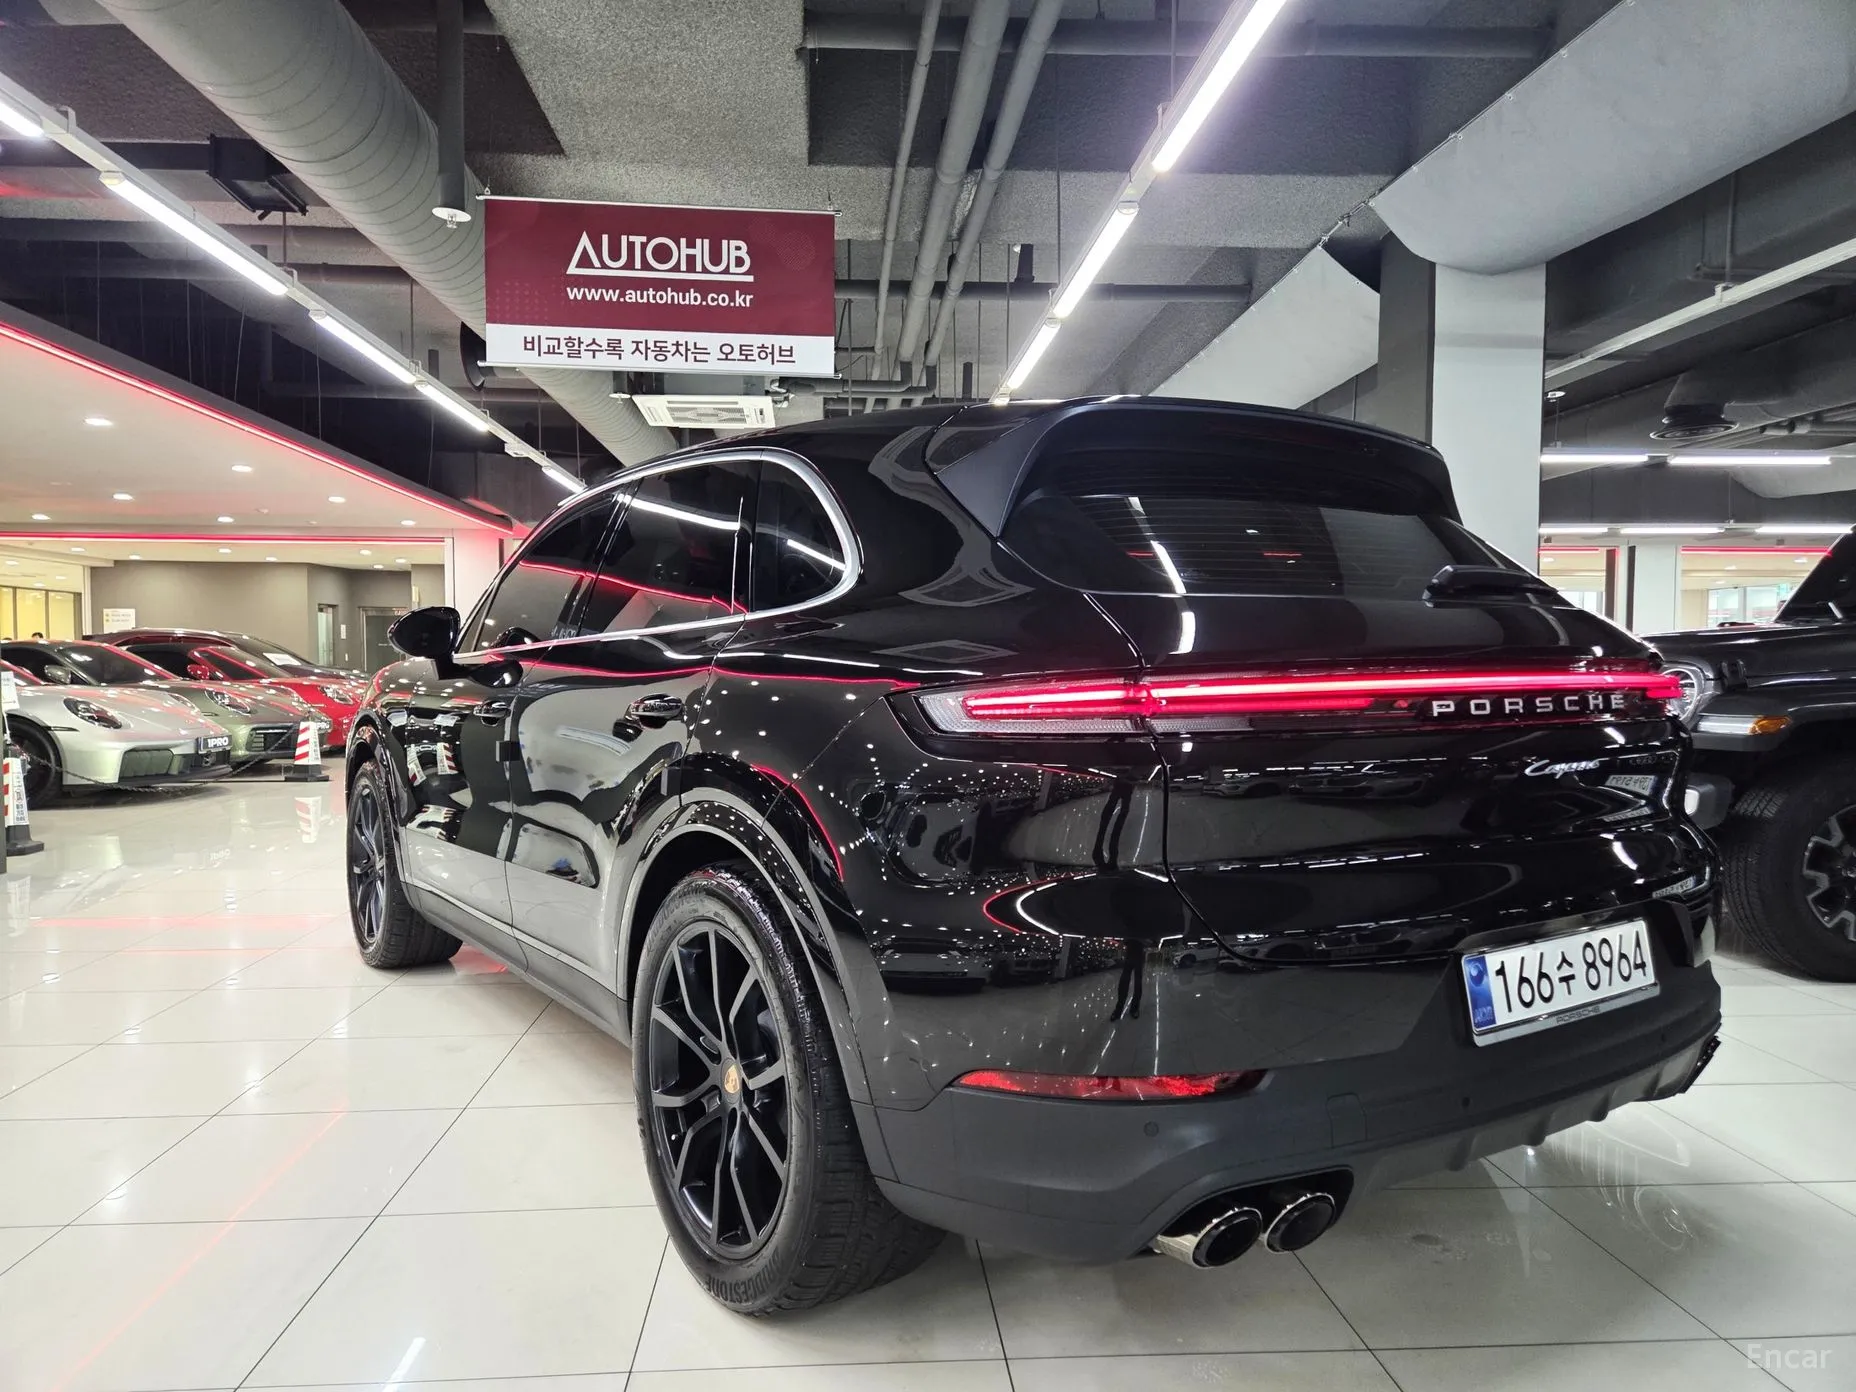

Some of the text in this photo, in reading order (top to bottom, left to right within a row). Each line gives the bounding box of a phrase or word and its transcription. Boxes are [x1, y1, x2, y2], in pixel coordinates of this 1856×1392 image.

[566, 231, 754, 282] AUTOHUB
[566, 286, 754, 308] www.autohub.co.kr
[523, 334, 796, 366] 비교할수록 자동차는 오토허브
[1432, 694, 1626, 717] PORSCHE
[1556, 1005, 1601, 1025] PORSCHE
